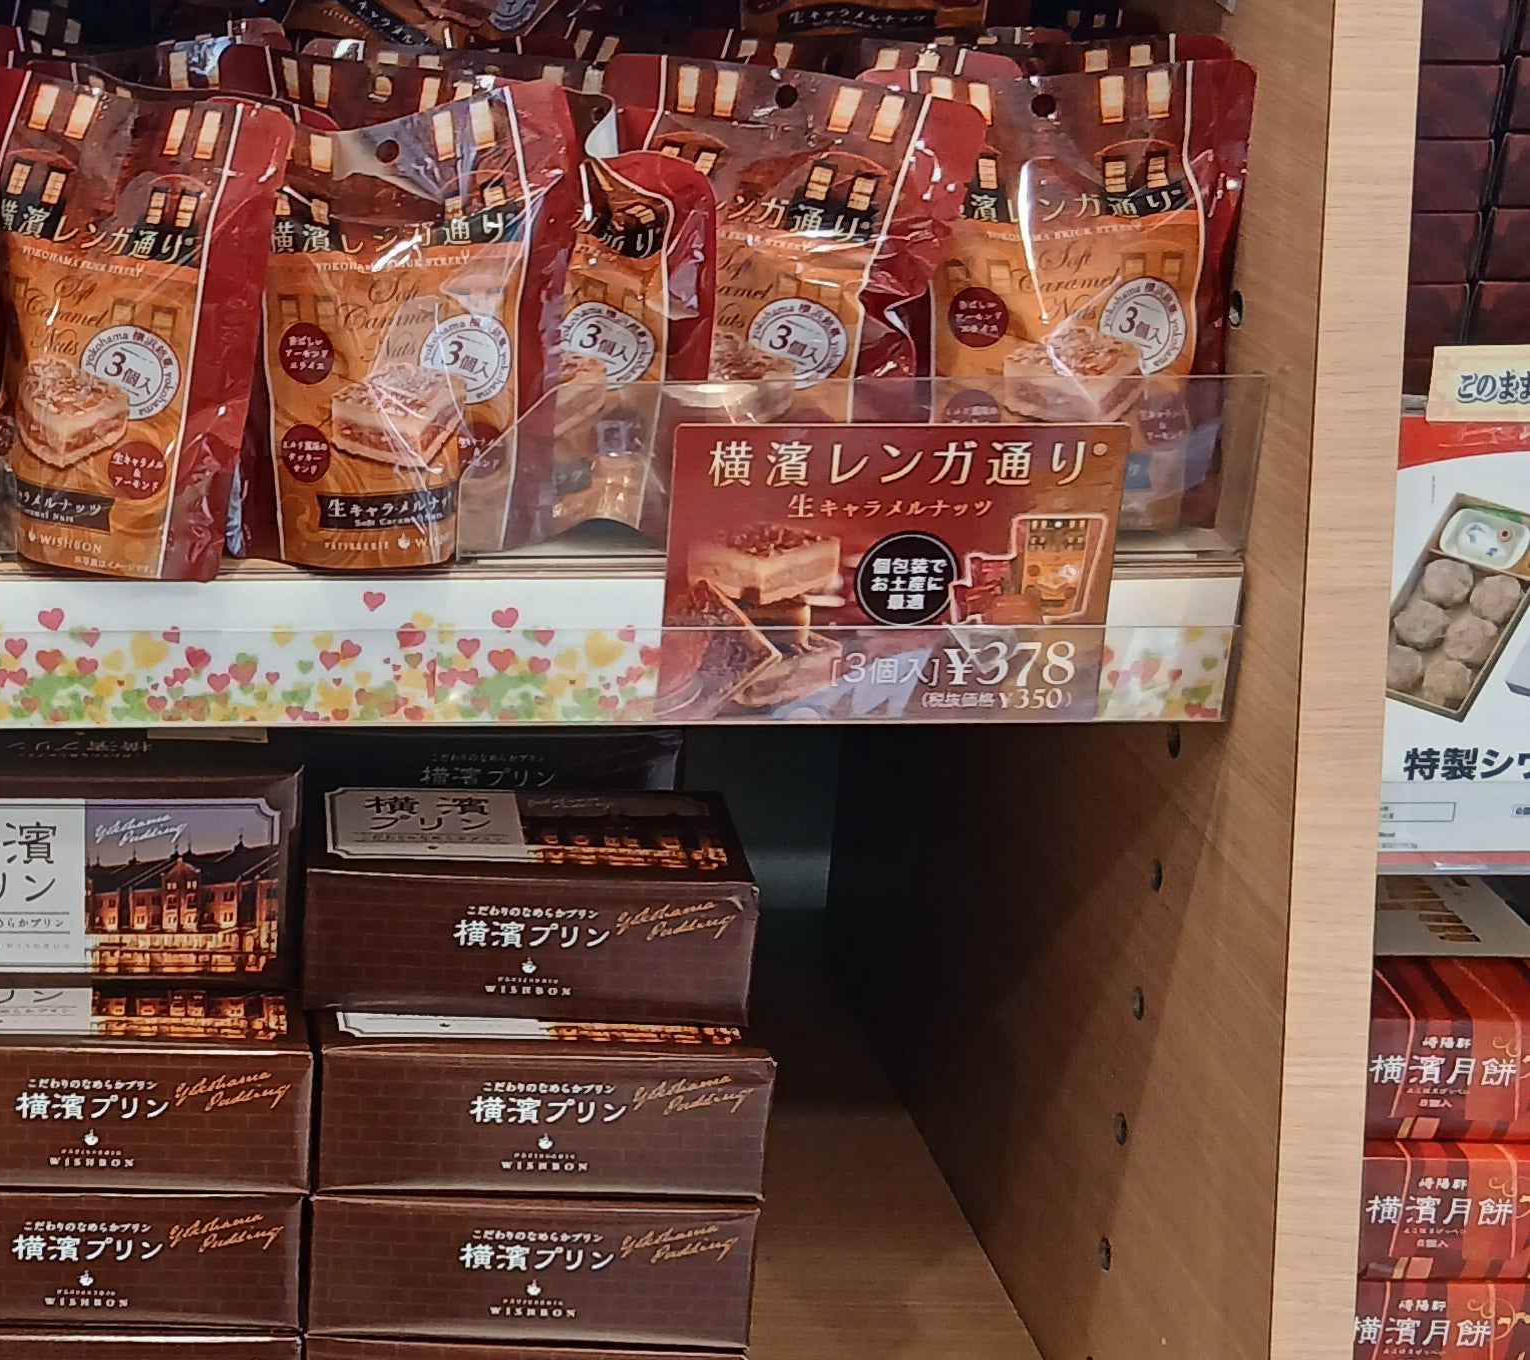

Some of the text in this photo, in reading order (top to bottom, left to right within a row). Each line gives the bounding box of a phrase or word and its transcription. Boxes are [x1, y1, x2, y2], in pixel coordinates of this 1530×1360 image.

[708, 439, 1086, 488] 横濱レンガ通り
[787, 493, 994, 521] 生キャラメルナッツ
[871, 557, 948, 575] 個包装で
[870, 576, 945, 594] お土産に
[886, 594, 925, 611] 最適
[452, 920, 611, 949] 横濱プリン
[1369, 1052, 1518, 1088] 横濱月餅
[15, 1092, 171, 1120] 横濱プリン
[469, 1096, 628, 1125] 横濱プリン
[1365, 1194, 1514, 1228] 横濱月餅
[1354, 1315, 1492, 1348] 横濱月餅
